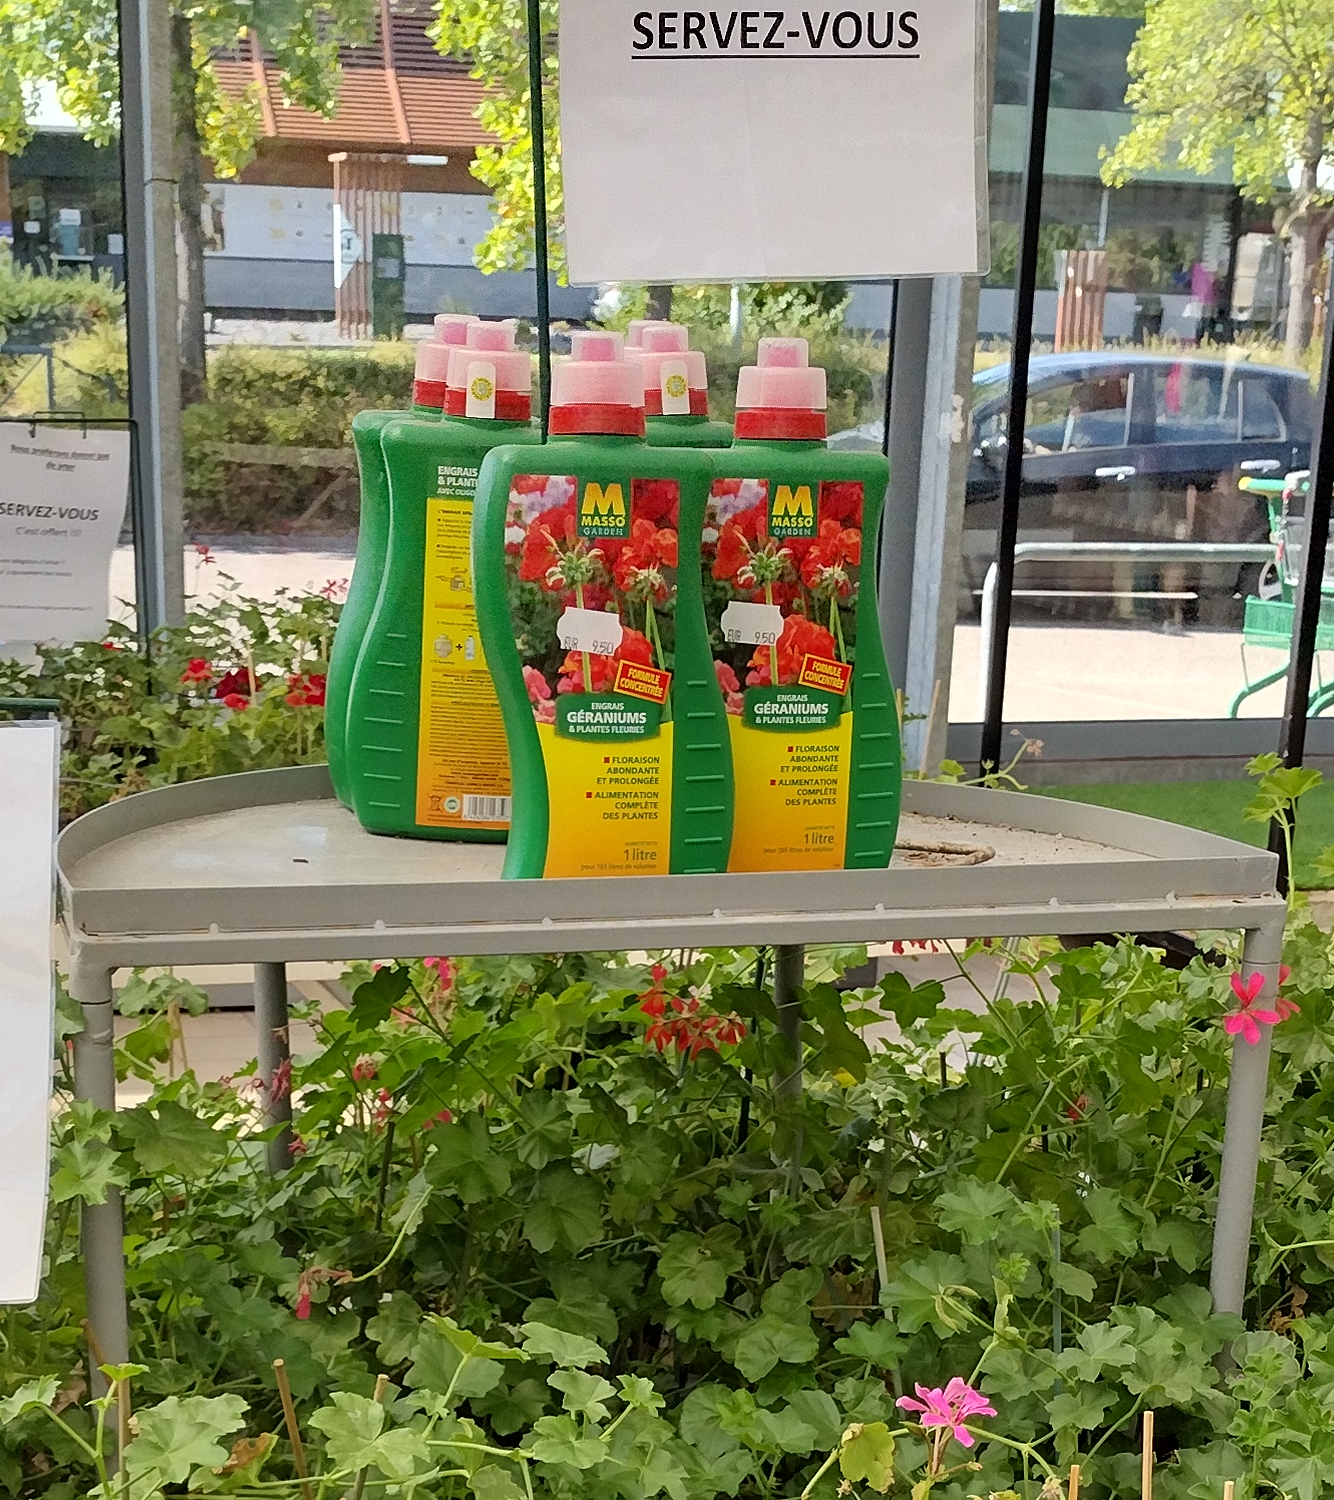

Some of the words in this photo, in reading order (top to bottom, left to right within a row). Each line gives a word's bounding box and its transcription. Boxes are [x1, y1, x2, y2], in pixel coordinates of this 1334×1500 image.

[631, 10, 920, 51] SERVEZ-VOUS
[438, 465, 478, 477] ENGRAIS
[583, 527, 623, 536] GARDEN
[773, 527, 811, 536] GARDEN
[728, 629, 741, 642] EUR
[812, 661, 842, 678] FORMULE
[627, 667, 661, 685] FORMULE
[620, 678, 663, 698] CONCENTRÉE
[777, 694, 808, 702] ENGRAIS
[591, 702, 624, 711] ENGRAIS
[754, 701, 829, 715] GÉRANIUMS
[567, 709, 647, 724] GÉRANIUMS
[763, 716, 794, 724] PLANTES
[795, 716, 826, 724] FLEURIES
[569, 725, 575, 733] &
[576, 725, 610, 733] PLANTES
[611, 725, 644, 734] FLEURIES
[796, 745, 840, 753] FLORAISON
[612, 756, 660, 764] FLORAISON
[790, 755, 839, 763] ABONDANTE
[606, 767, 659, 775] ABONDANTE
[792, 764, 838, 773] PROLONGÉE
[597, 777, 606, 785] ET
[609, 776, 659, 785] PROLONGÉE
[778, 778, 838, 786] ALIMENTATION
[595, 791, 659, 799] ALIMENTATION
[797, 788, 837, 796] COMPLÈTE
[615, 801, 658, 810] COMPLÈTE
[785, 798, 801, 806] DES
[803, 798, 837, 806] PLANTES
[603, 812, 619, 820] DES
[622, 812, 658, 820] PLANTES
[804, 833, 809, 844] 1
[812, 832, 835, 844] litre
[624, 849, 629, 860] 1
[633, 848, 657, 860] litre
